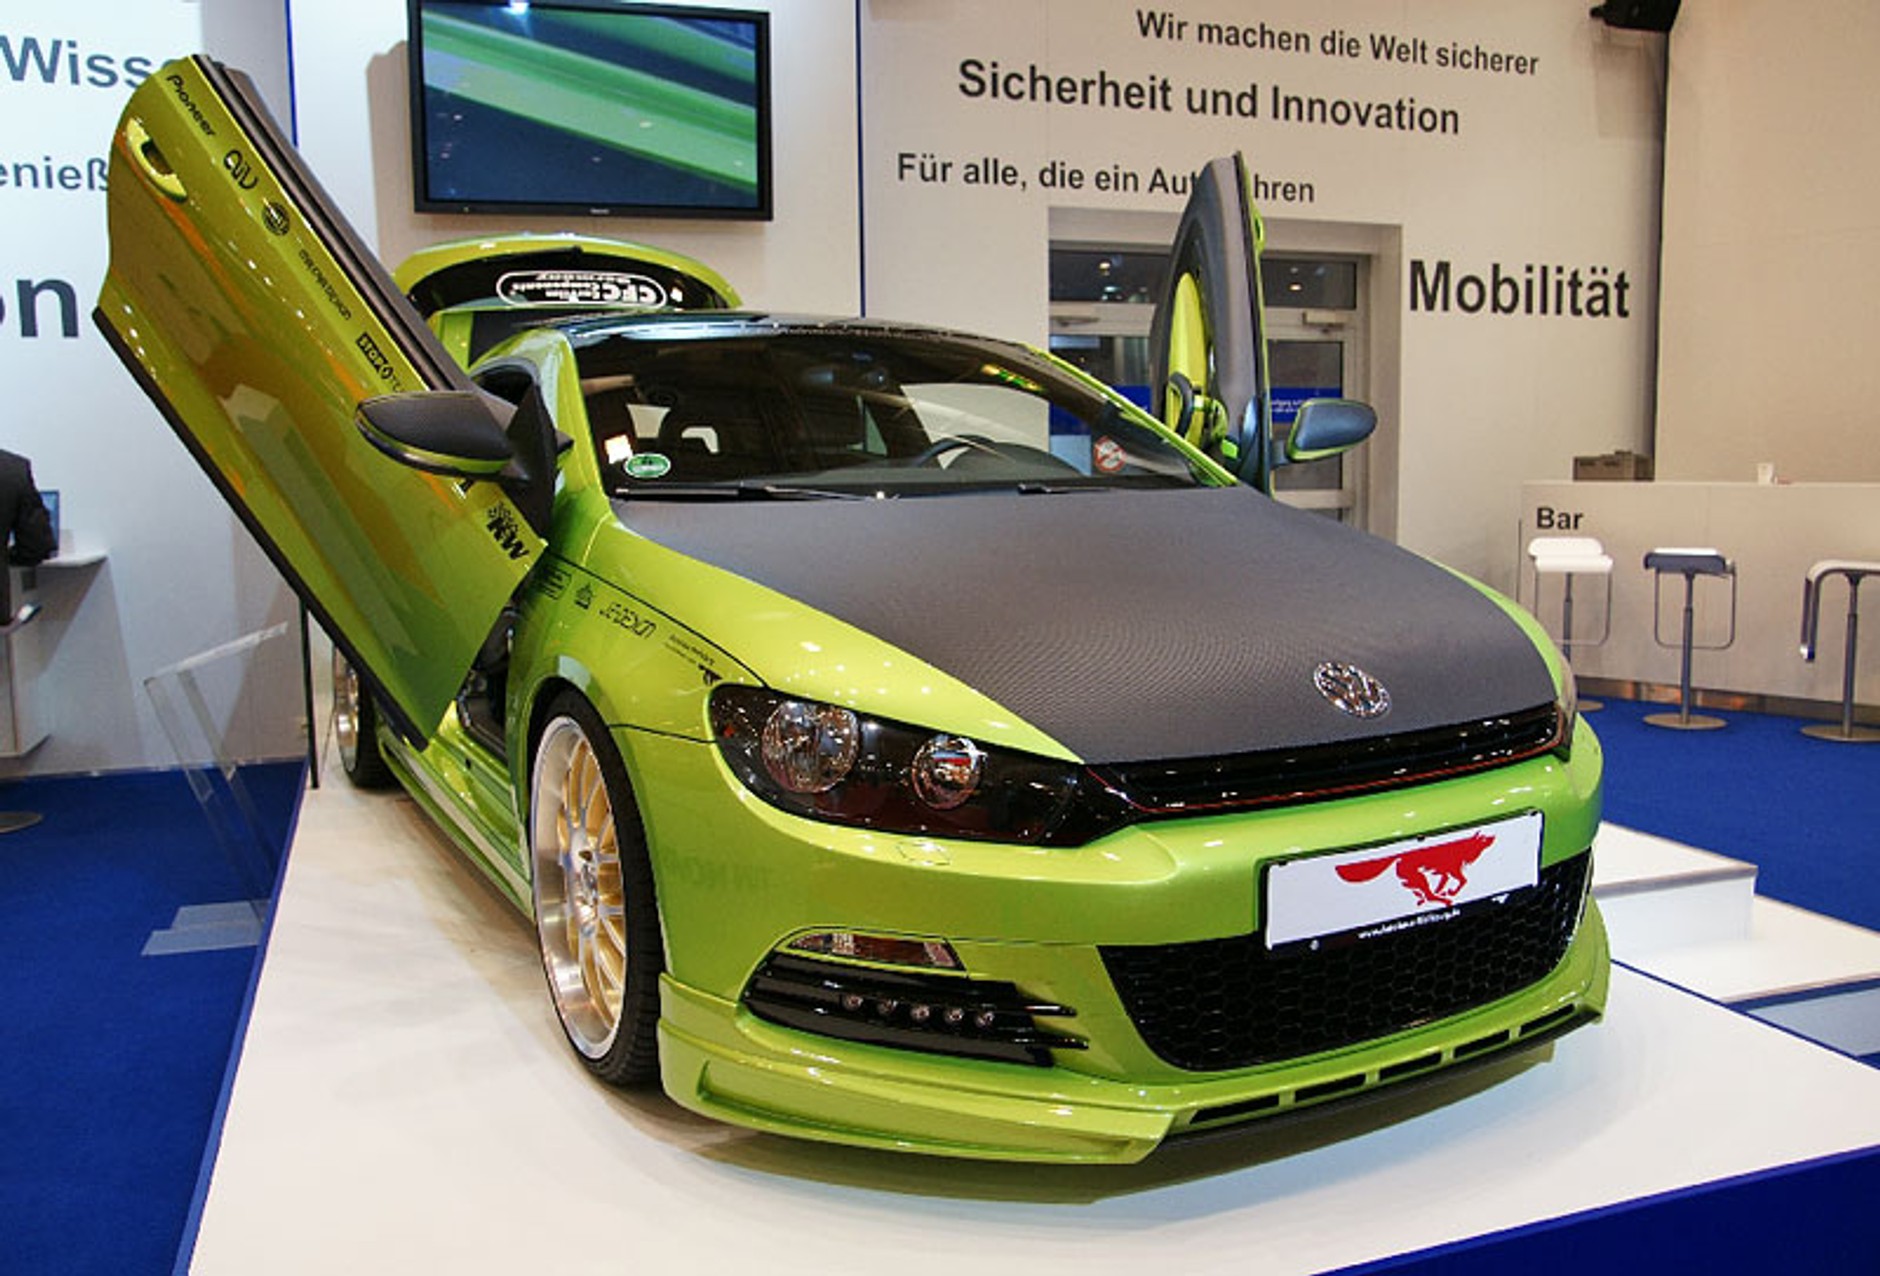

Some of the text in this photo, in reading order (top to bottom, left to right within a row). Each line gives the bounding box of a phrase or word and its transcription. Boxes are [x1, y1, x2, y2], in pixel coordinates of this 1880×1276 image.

[1137, 10, 1539, 75] Wir machen die Welt sicherer
[959, 59, 1459, 135] Sicherheit und Innovation
[898, 153, 953, 184] Für
[964, 158, 1028, 191] alle,
[1039, 160, 1084, 190] die
[1095, 165, 1139, 193] ein
[1149, 168, 1199, 196] Aut
[1410, 260, 1631, 319] Mobilität
[1536, 506, 1584, 530] Bar
